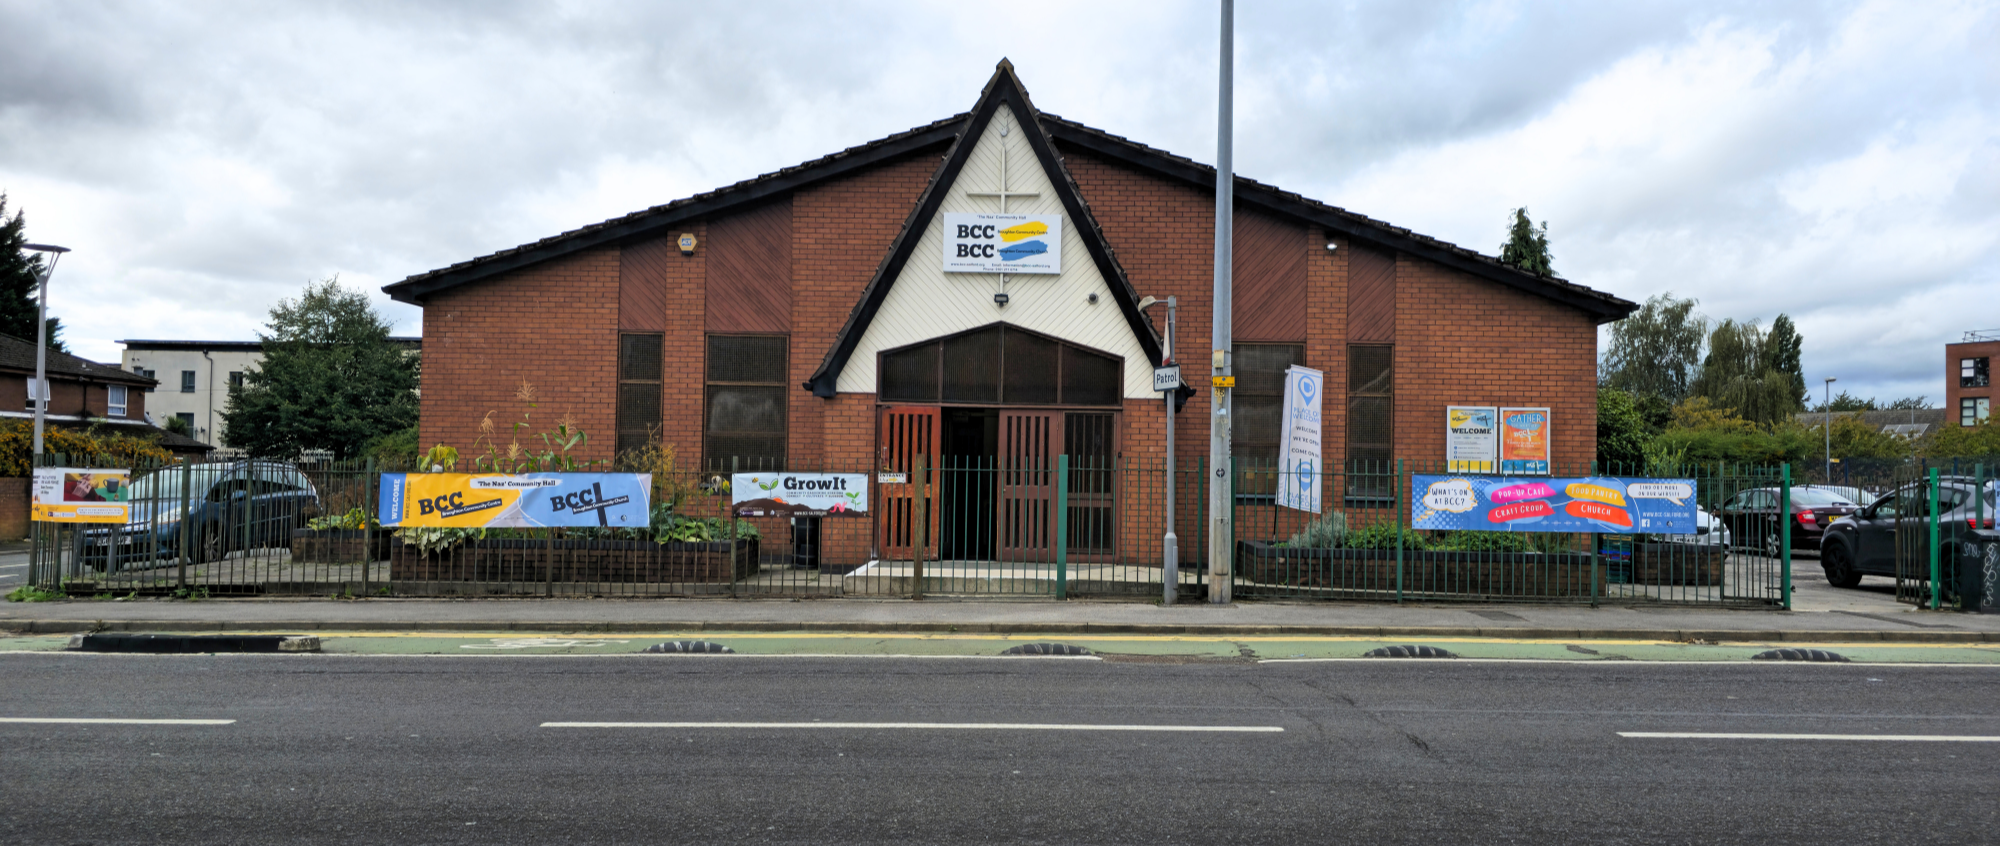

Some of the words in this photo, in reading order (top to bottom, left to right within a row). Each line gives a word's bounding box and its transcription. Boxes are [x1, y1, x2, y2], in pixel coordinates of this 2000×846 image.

[957, 224, 995, 239] BCC
[956, 244, 994, 258] BCC
[1156, 371, 1177, 384] Patrol
[1294, 407, 1310, 415] PLACE
[1293, 412, 1320, 424] WELCOME
[1296, 426, 1318, 435] WELCOME
[1293, 436, 1308, 444] WE'RE
[784, 476, 847, 490] GrowIt
[1431, 488, 1457, 496] WHAT'S
[1499, 489, 1525, 499] POP-UP
[1591, 489, 1618, 500] PANTRY
[392, 479, 400, 520] WELCOME
[418, 491, 464, 515] BCC
[550, 488, 593, 512] BCC
[1444, 498, 1464, 506] BCC?
[442, 508, 464, 516] Broughton
[464, 503, 487, 512] Community
[573, 504, 593, 513] Broughton
[593, 500, 614, 508] Community
[1495, 508, 1518, 518] CRAFT
[1520, 504, 1544, 514] GROUP
[1581, 504, 1611, 516] CHURCH
